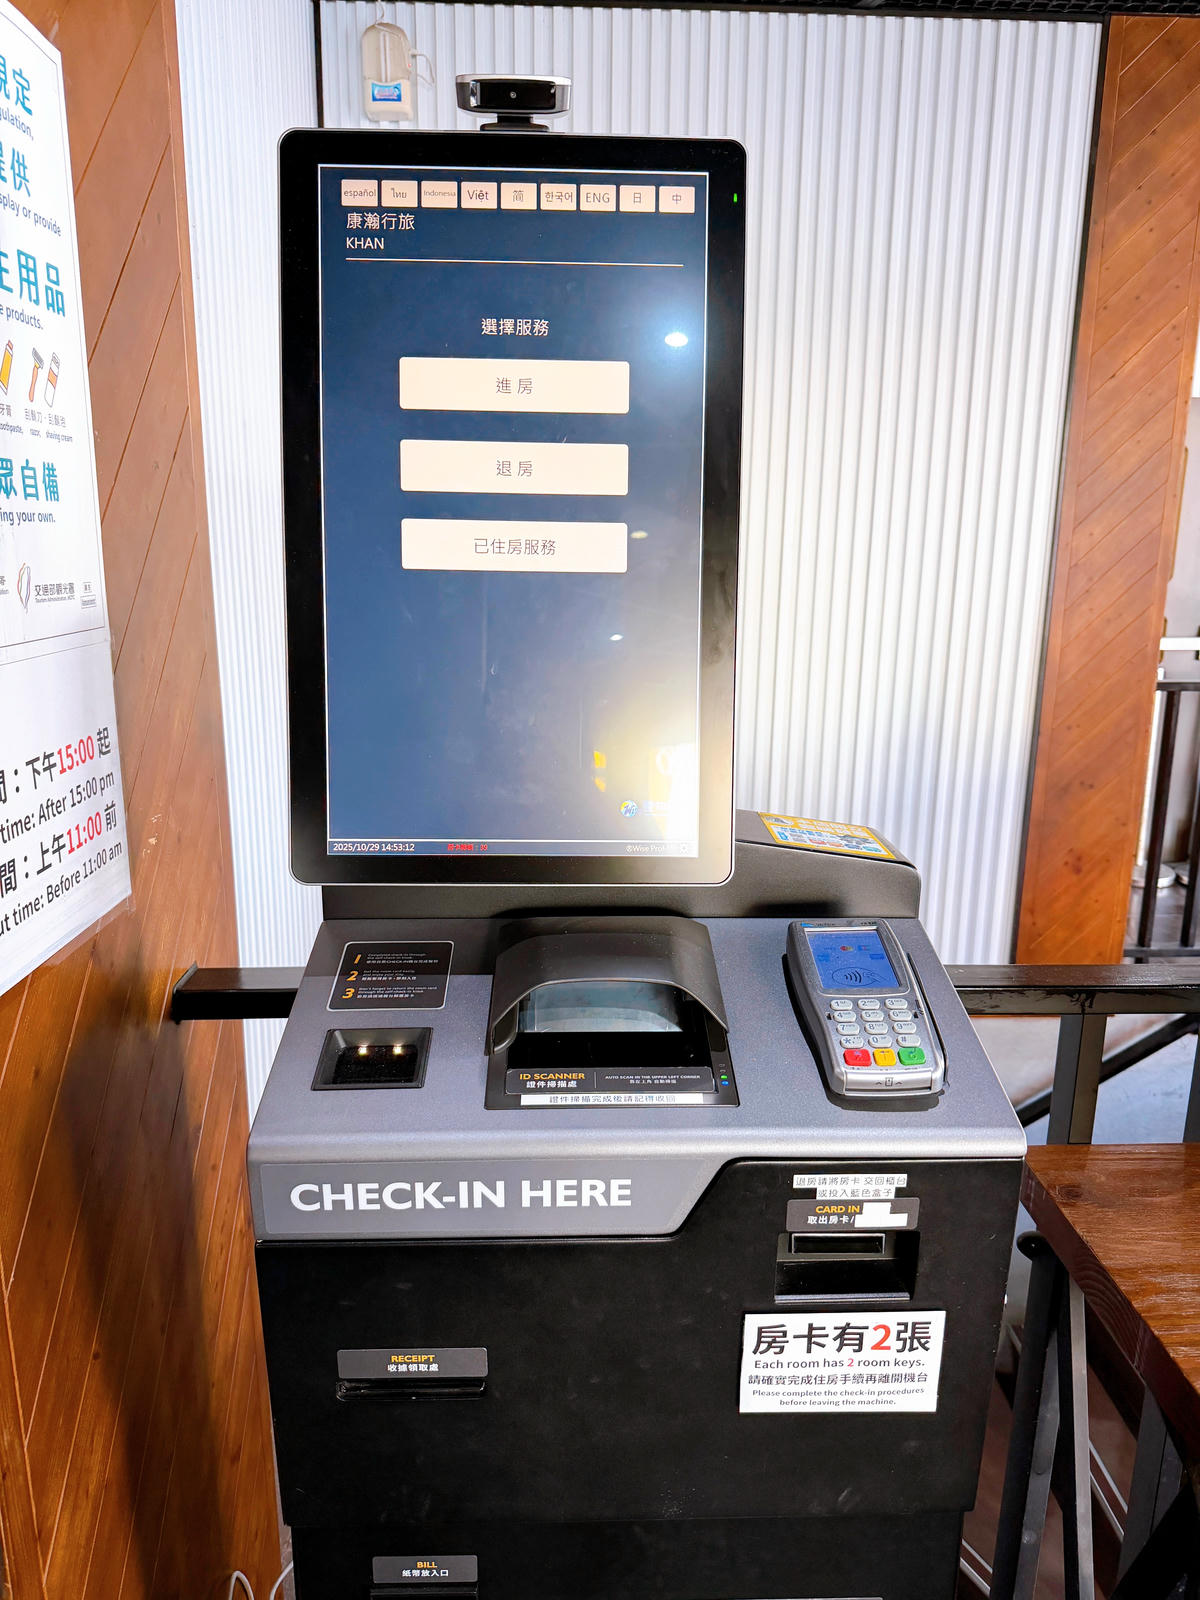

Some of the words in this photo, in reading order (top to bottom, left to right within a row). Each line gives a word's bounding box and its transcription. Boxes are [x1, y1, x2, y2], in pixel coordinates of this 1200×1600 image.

[0, 107, 34, 141] ulation,
[343, 188, 377, 199] español
[390, 187, 408, 199] ไทย
[423, 189, 457, 198] Indonesia
[467, 189, 489, 203] Việt
[544, 191, 574, 203] 한국어
[585, 192, 611, 204] ENG
[633, 192, 642, 204] 日
[671, 193, 682, 205] 中
[22, 206, 31, 219] or
[34, 212, 61, 237] provide
[346, 212, 416, 231] 康瀚行旅
[346, 236, 385, 250] KHAN
[6, 306, 43, 330] products.
[481, 318, 550, 337] 選擇服務
[16, 511, 35, 526] your
[38, 512, 56, 523] own.
[473, 538, 557, 556] 已住房服務
[0, 813, 36, 844] time:
[39, 797, 67, 825] After
[70, 777, 98, 808] 15:00
[100, 771, 115, 797] pm
[332, 843, 380, 852] 2025/10/29
[381, 843, 415, 852] 14:53:12
[13, 894, 44, 926] time:
[47, 870, 81, 904] Before
[83, 848, 107, 879] 11:00
[109, 842, 122, 861] am
[533, 1072, 586, 1080] SCANNER
[290, 1180, 506, 1212] CHECK-IN
[521, 1178, 633, 1208] HERE
[815, 1205, 846, 1214] CARD
[847, 1205, 861, 1214] IN
[752, 1321, 933, 1355] 房卡有2張
[391, 1354, 436, 1363] RECEIPT
[754, 1359, 784, 1369] Each
[787, 1360, 820, 1369] room
[823, 1358, 844, 1368] has
[847, 1358, 855, 1367] 2
[857, 1359, 890, 1367] room
[893, 1357, 926, 1369] keys.
[752, 1389, 781, 1397] Please
[782, 1389, 823, 1398] complete
[824, 1389, 838, 1397] the
[839, 1389, 876, 1397] check-in
[877, 1387, 925, 1398] procedures
[809, 1398, 840, 1407] leaving
[857, 1398, 897, 1406] machine.
[416, 1561, 438, 1569] BILL
